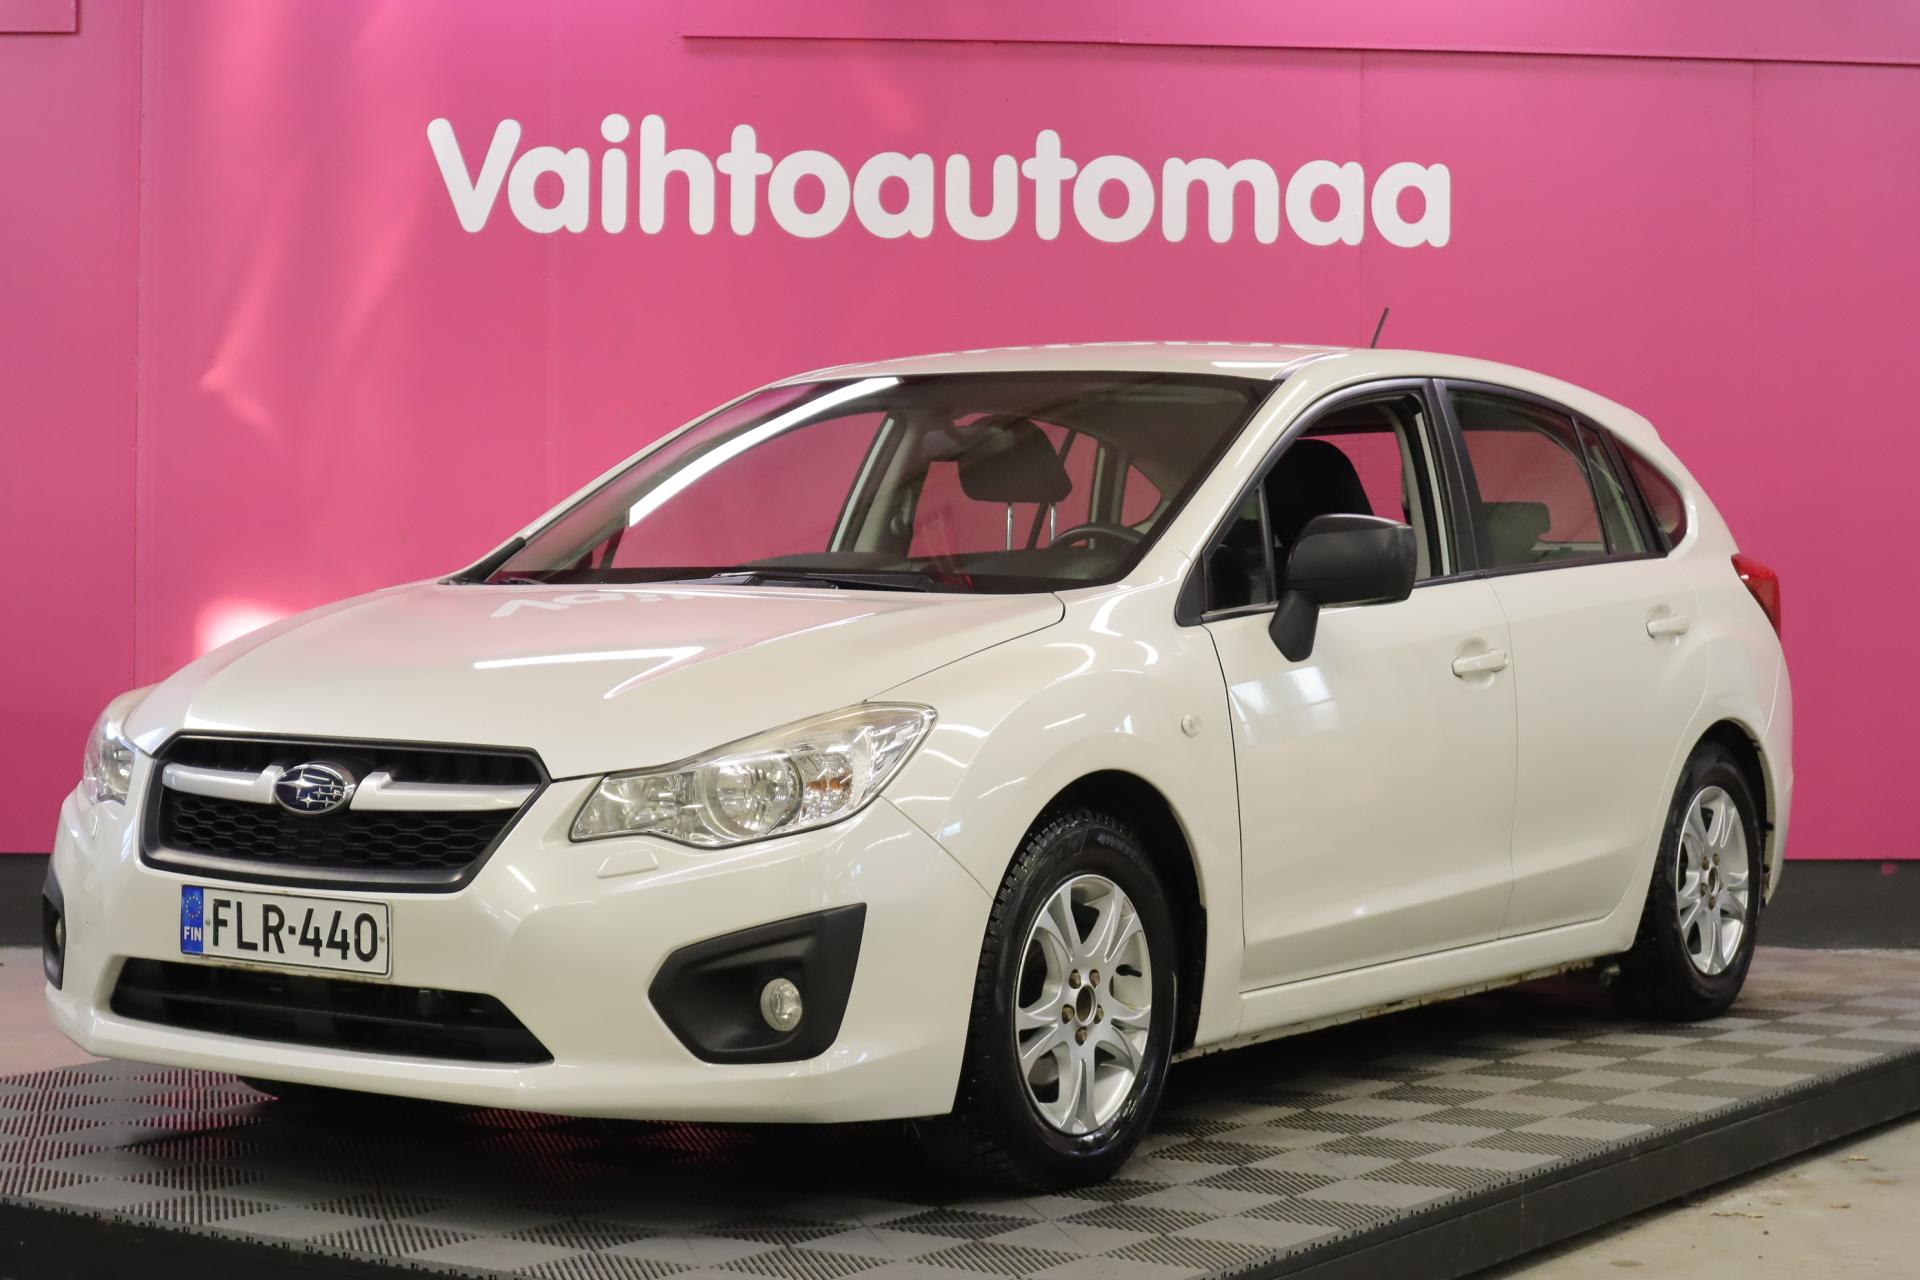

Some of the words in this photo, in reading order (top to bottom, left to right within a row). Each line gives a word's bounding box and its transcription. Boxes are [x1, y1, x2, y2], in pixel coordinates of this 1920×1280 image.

[427, 114, 1451, 248] Vaihtoautomaa
[183, 925, 202, 941] FIN
[212, 898, 378, 963] FLR-440
